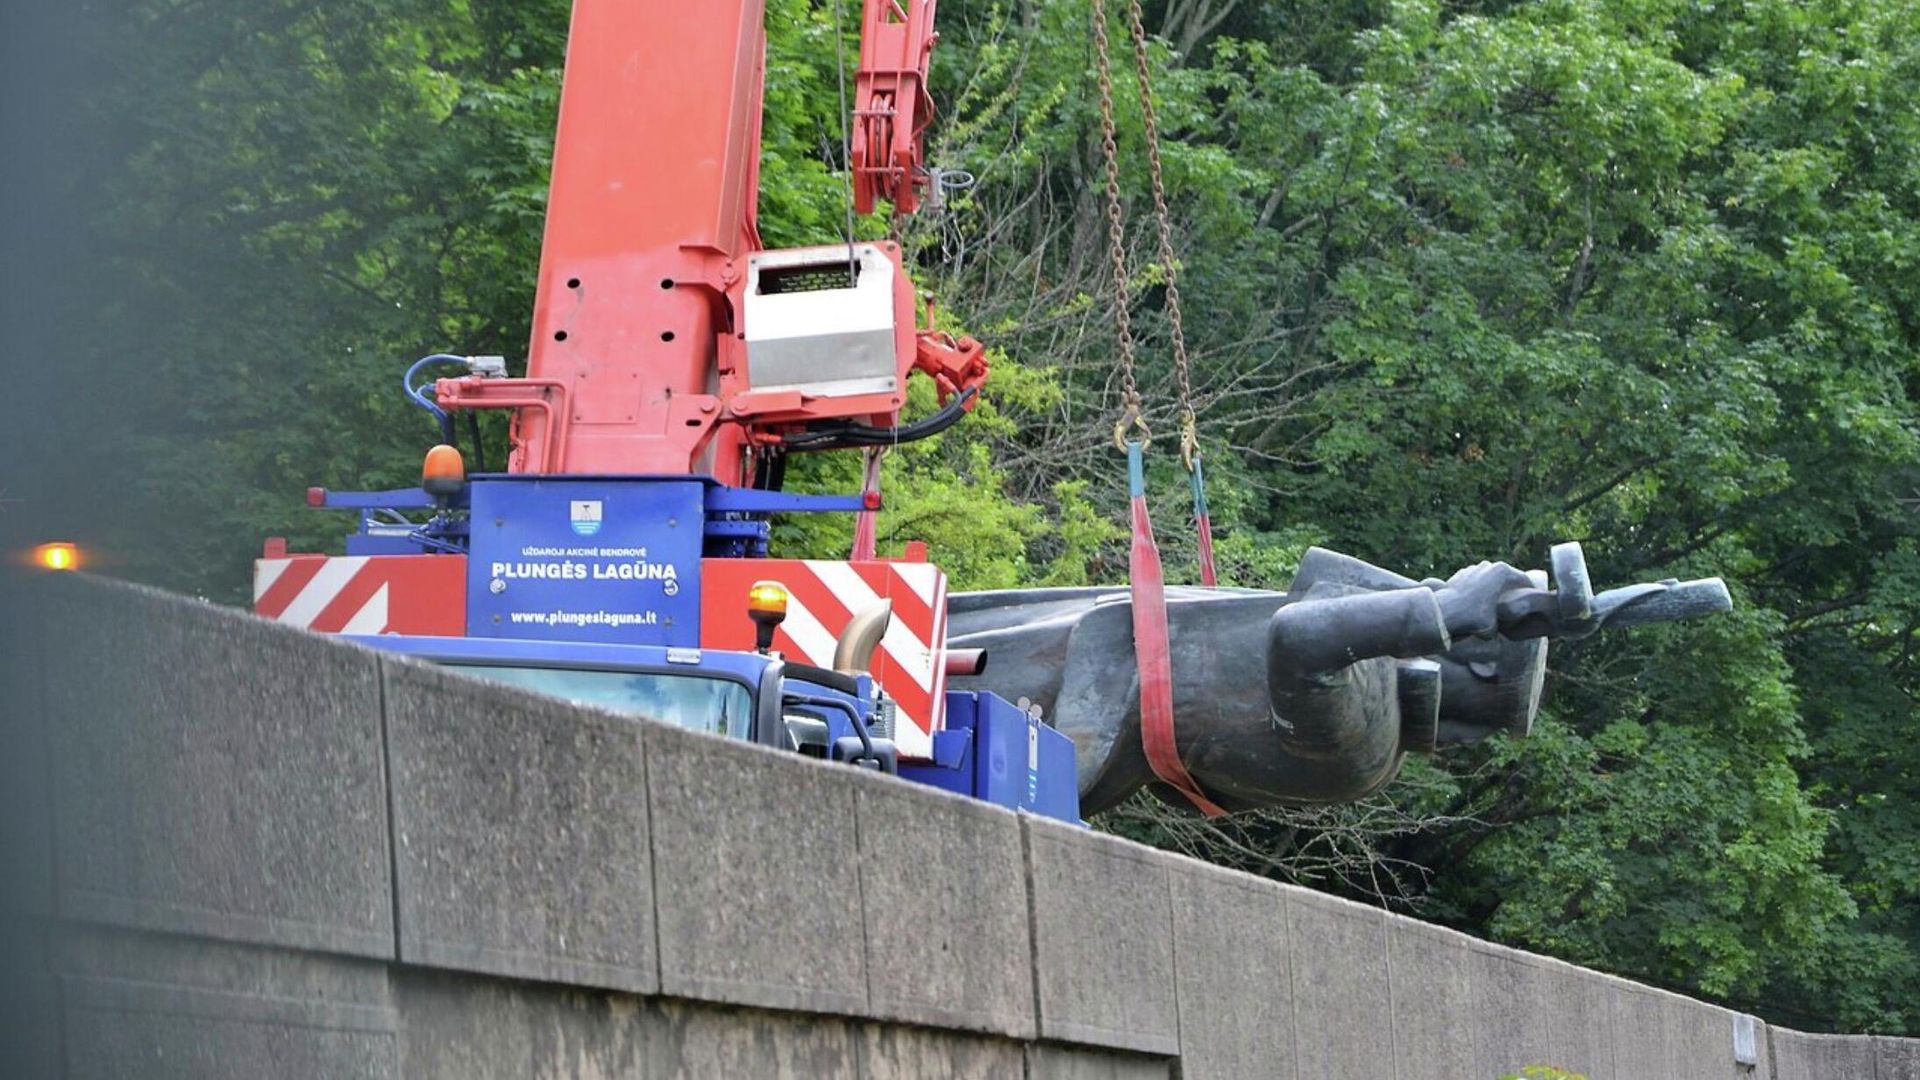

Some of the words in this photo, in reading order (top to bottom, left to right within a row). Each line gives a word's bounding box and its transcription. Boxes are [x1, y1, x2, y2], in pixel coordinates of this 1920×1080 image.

[522, 547, 565, 557] UŽDAROJI
[566, 547, 598, 557] AKCINĖ
[600, 547, 647, 558] BENDROVĖ
[492, 560, 588, 579] PLUNGĖS
[593, 560, 677, 580] LAGŪNA
[511, 610, 657, 627] www.plungeslaguna.lt
